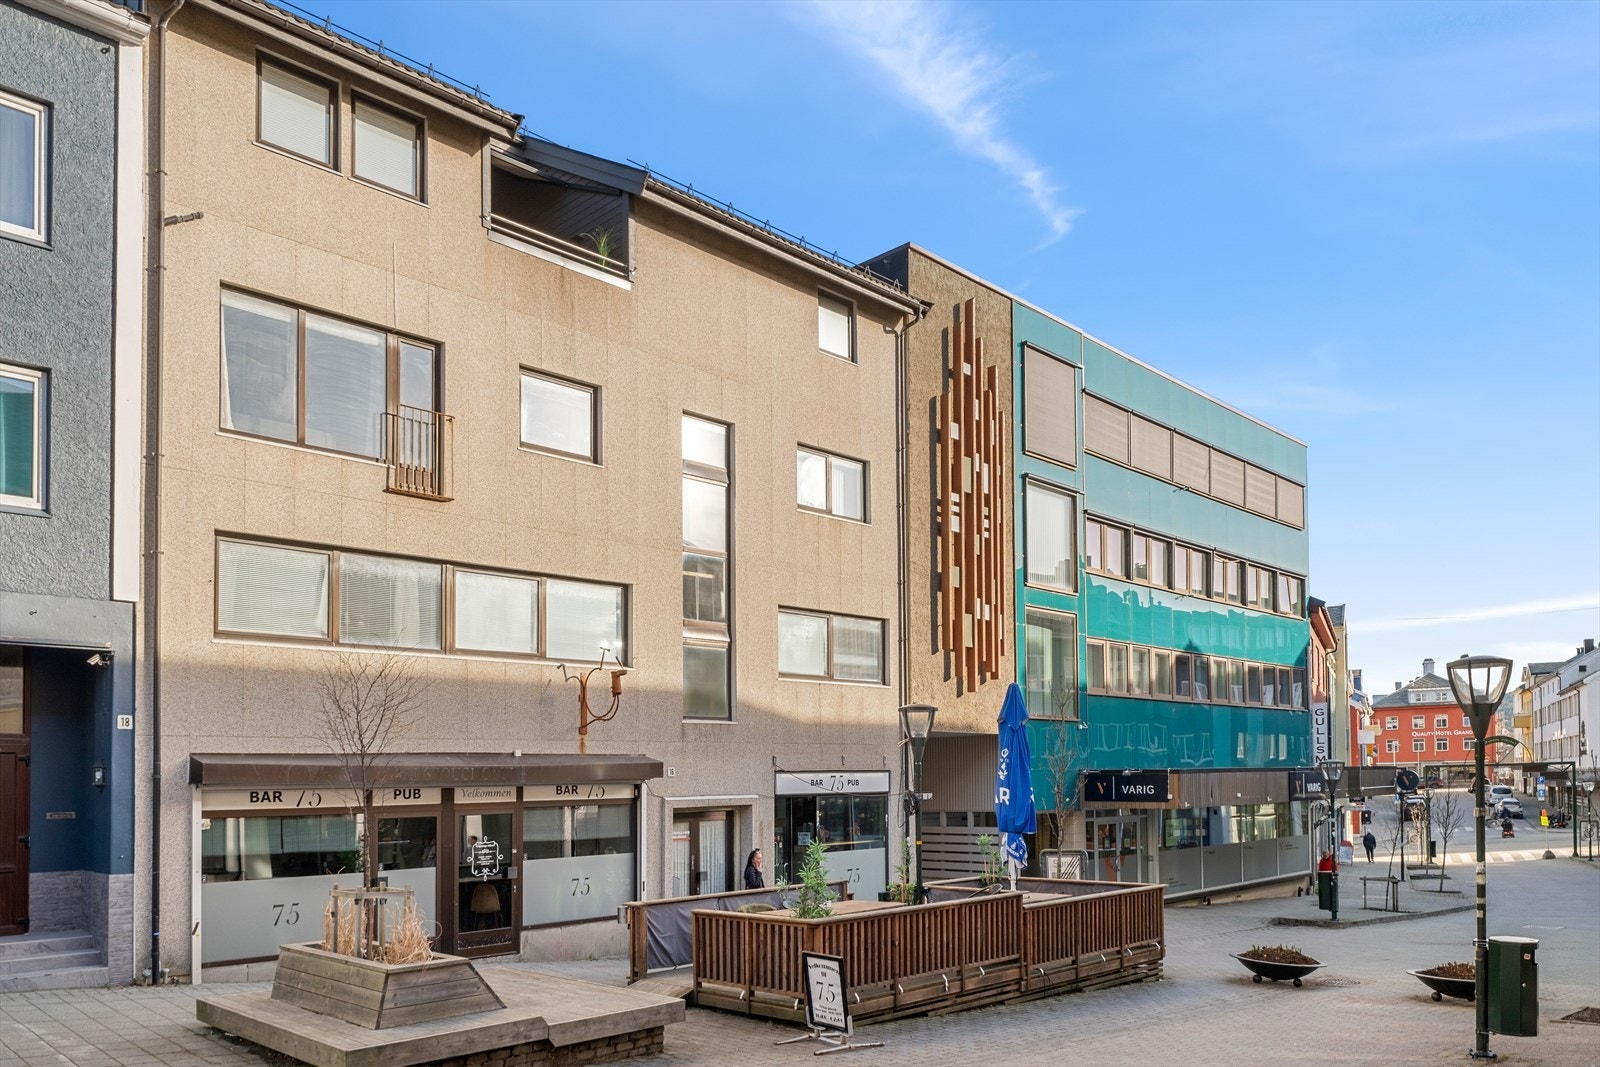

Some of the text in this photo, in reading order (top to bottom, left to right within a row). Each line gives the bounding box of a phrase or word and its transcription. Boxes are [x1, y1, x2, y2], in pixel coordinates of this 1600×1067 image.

[120, 717, 130, 727] 18
[555, 785, 579, 796] BAR
[810, 775, 860, 792] BAR 75 PUB
[1121, 784, 1155, 795] VARIG
[1307, 782, 1322, 793] VARIG
[249, 788, 422, 807] BAR 75 PUB
[460, 788, 512, 799] Velkommen
[847, 868, 861, 884] 75
[571, 877, 591, 897] 75
[272, 902, 300, 926] 75
[816, 981, 836, 1003] 75
